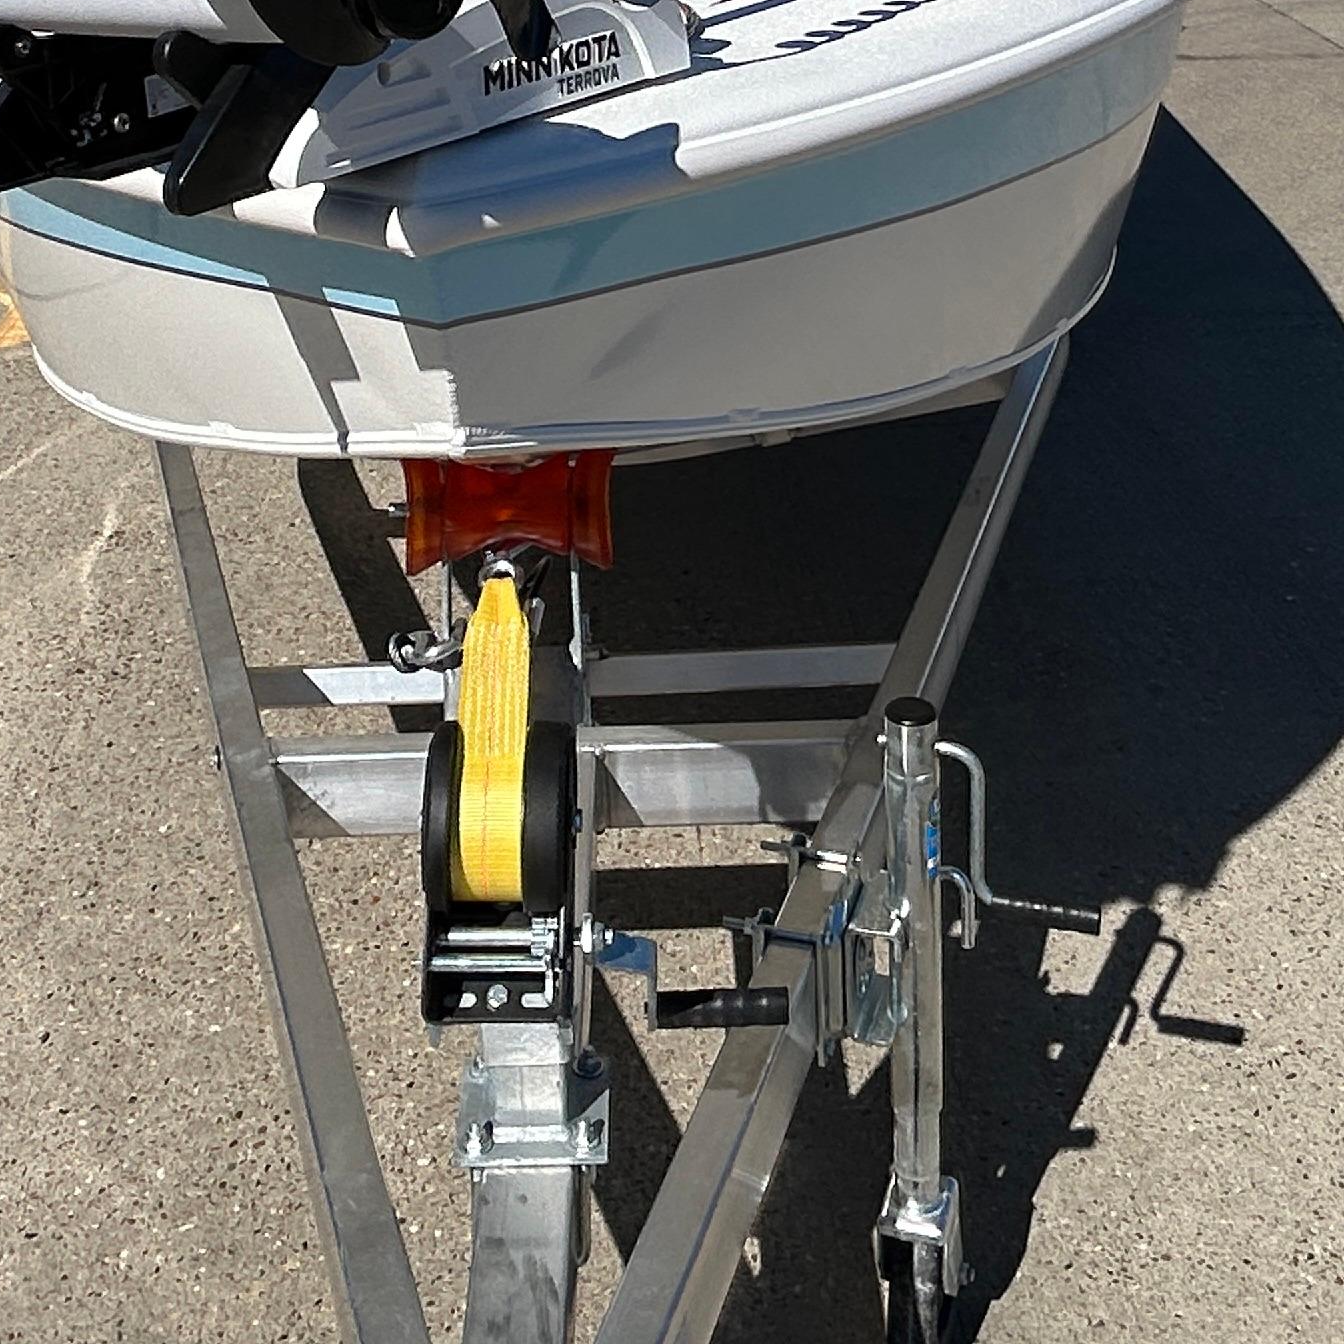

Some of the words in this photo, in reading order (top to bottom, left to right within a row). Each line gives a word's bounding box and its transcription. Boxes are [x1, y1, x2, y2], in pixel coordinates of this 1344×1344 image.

[483, 56, 552, 97] MINN
[558, 31, 622, 74] KOTA
[557, 63, 621, 98] TERROVA
